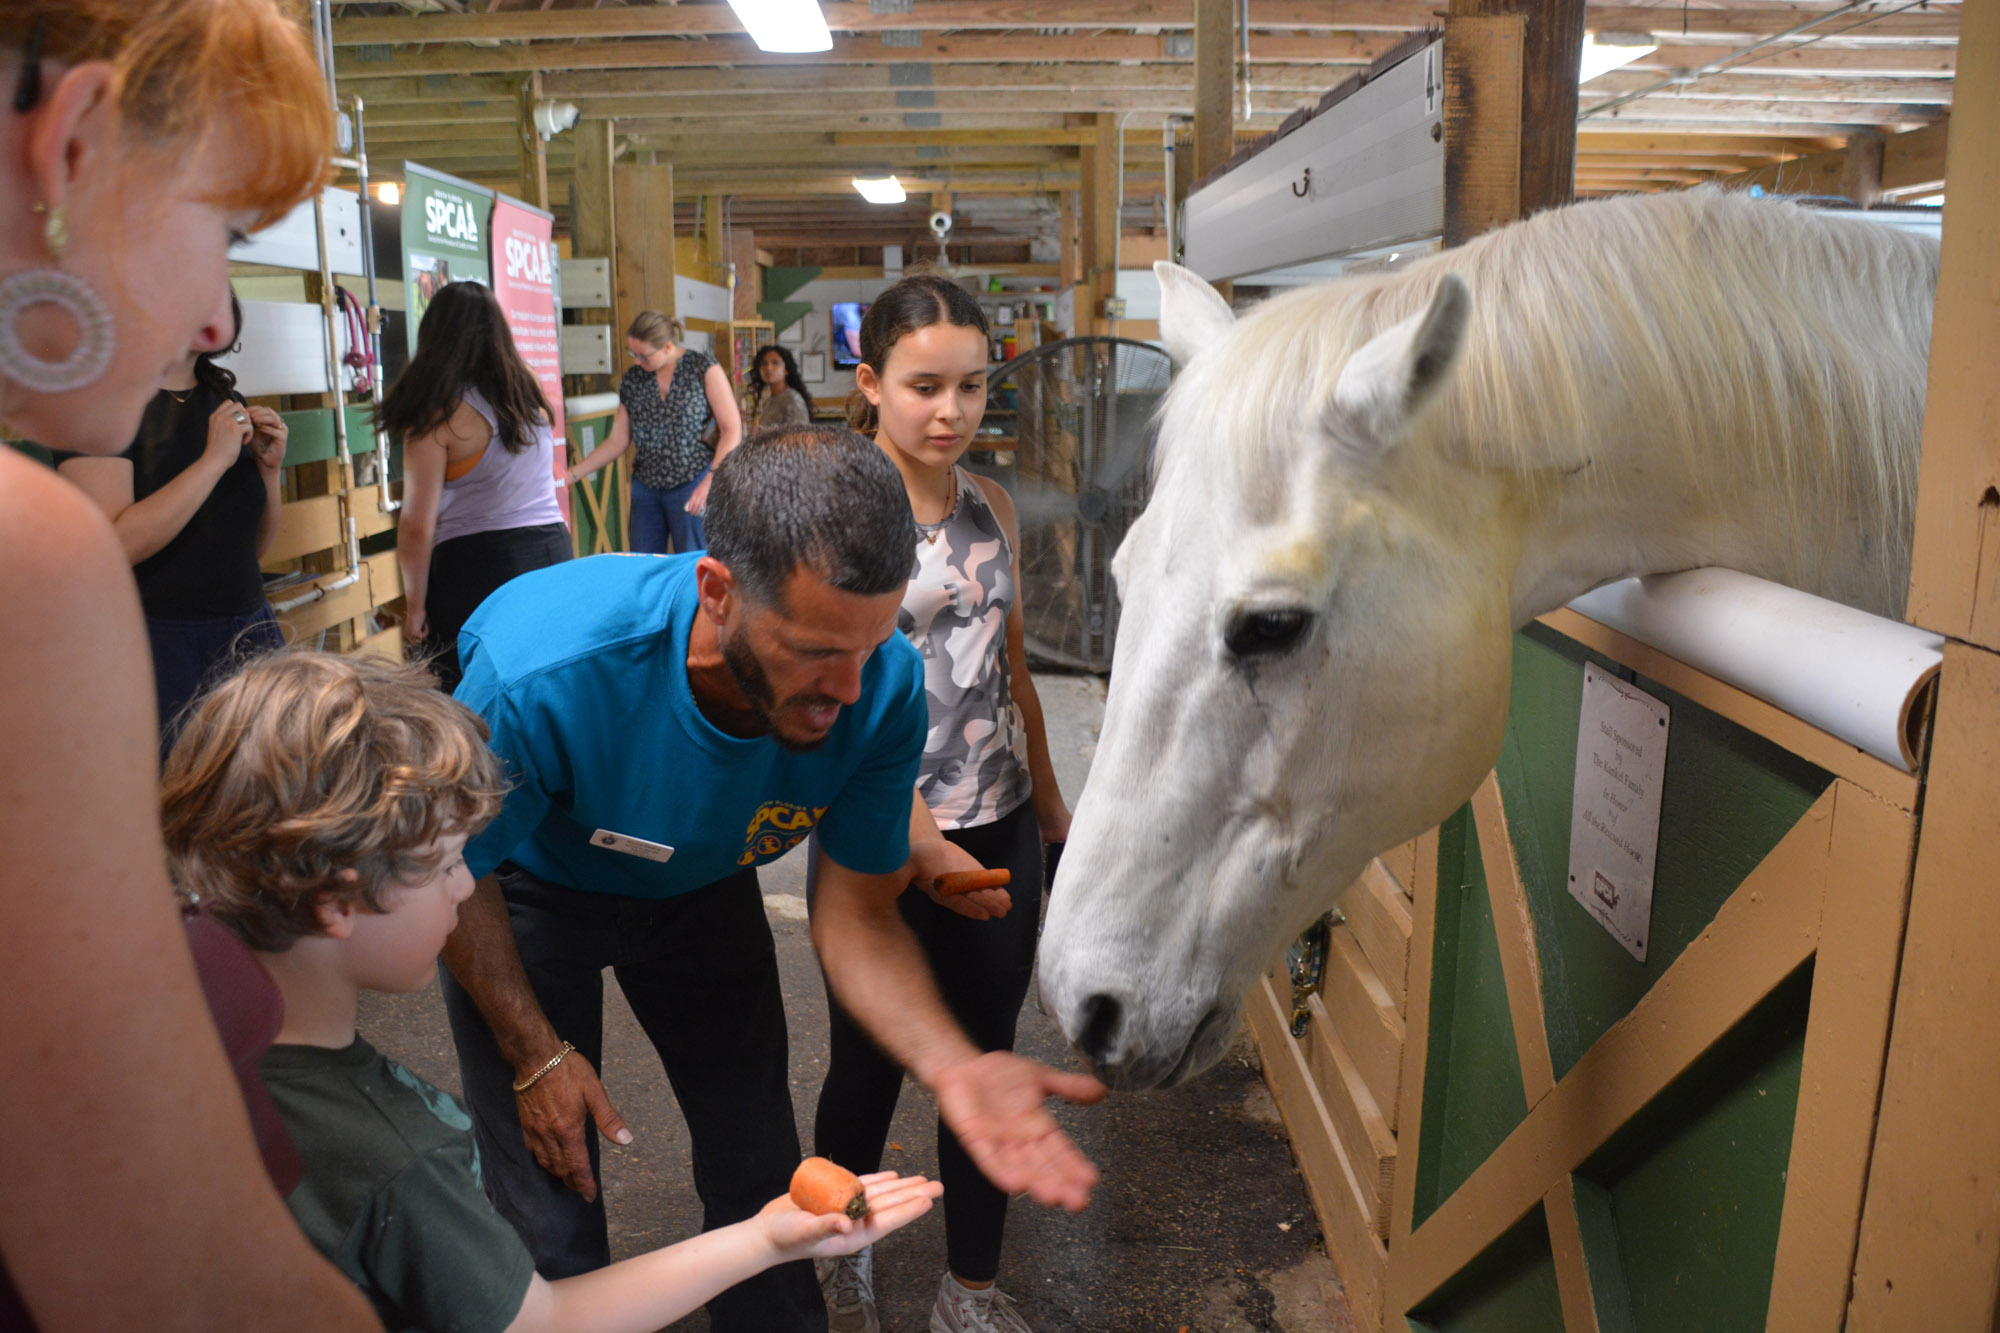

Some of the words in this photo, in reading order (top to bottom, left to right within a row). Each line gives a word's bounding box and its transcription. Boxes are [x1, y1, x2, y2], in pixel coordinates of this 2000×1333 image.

[1426, 49, 1435, 111] 4
[425, 195, 468, 241] SPCA
[505, 236, 544, 284] SPCA
[1613, 729, 1643, 757] Sponsored
